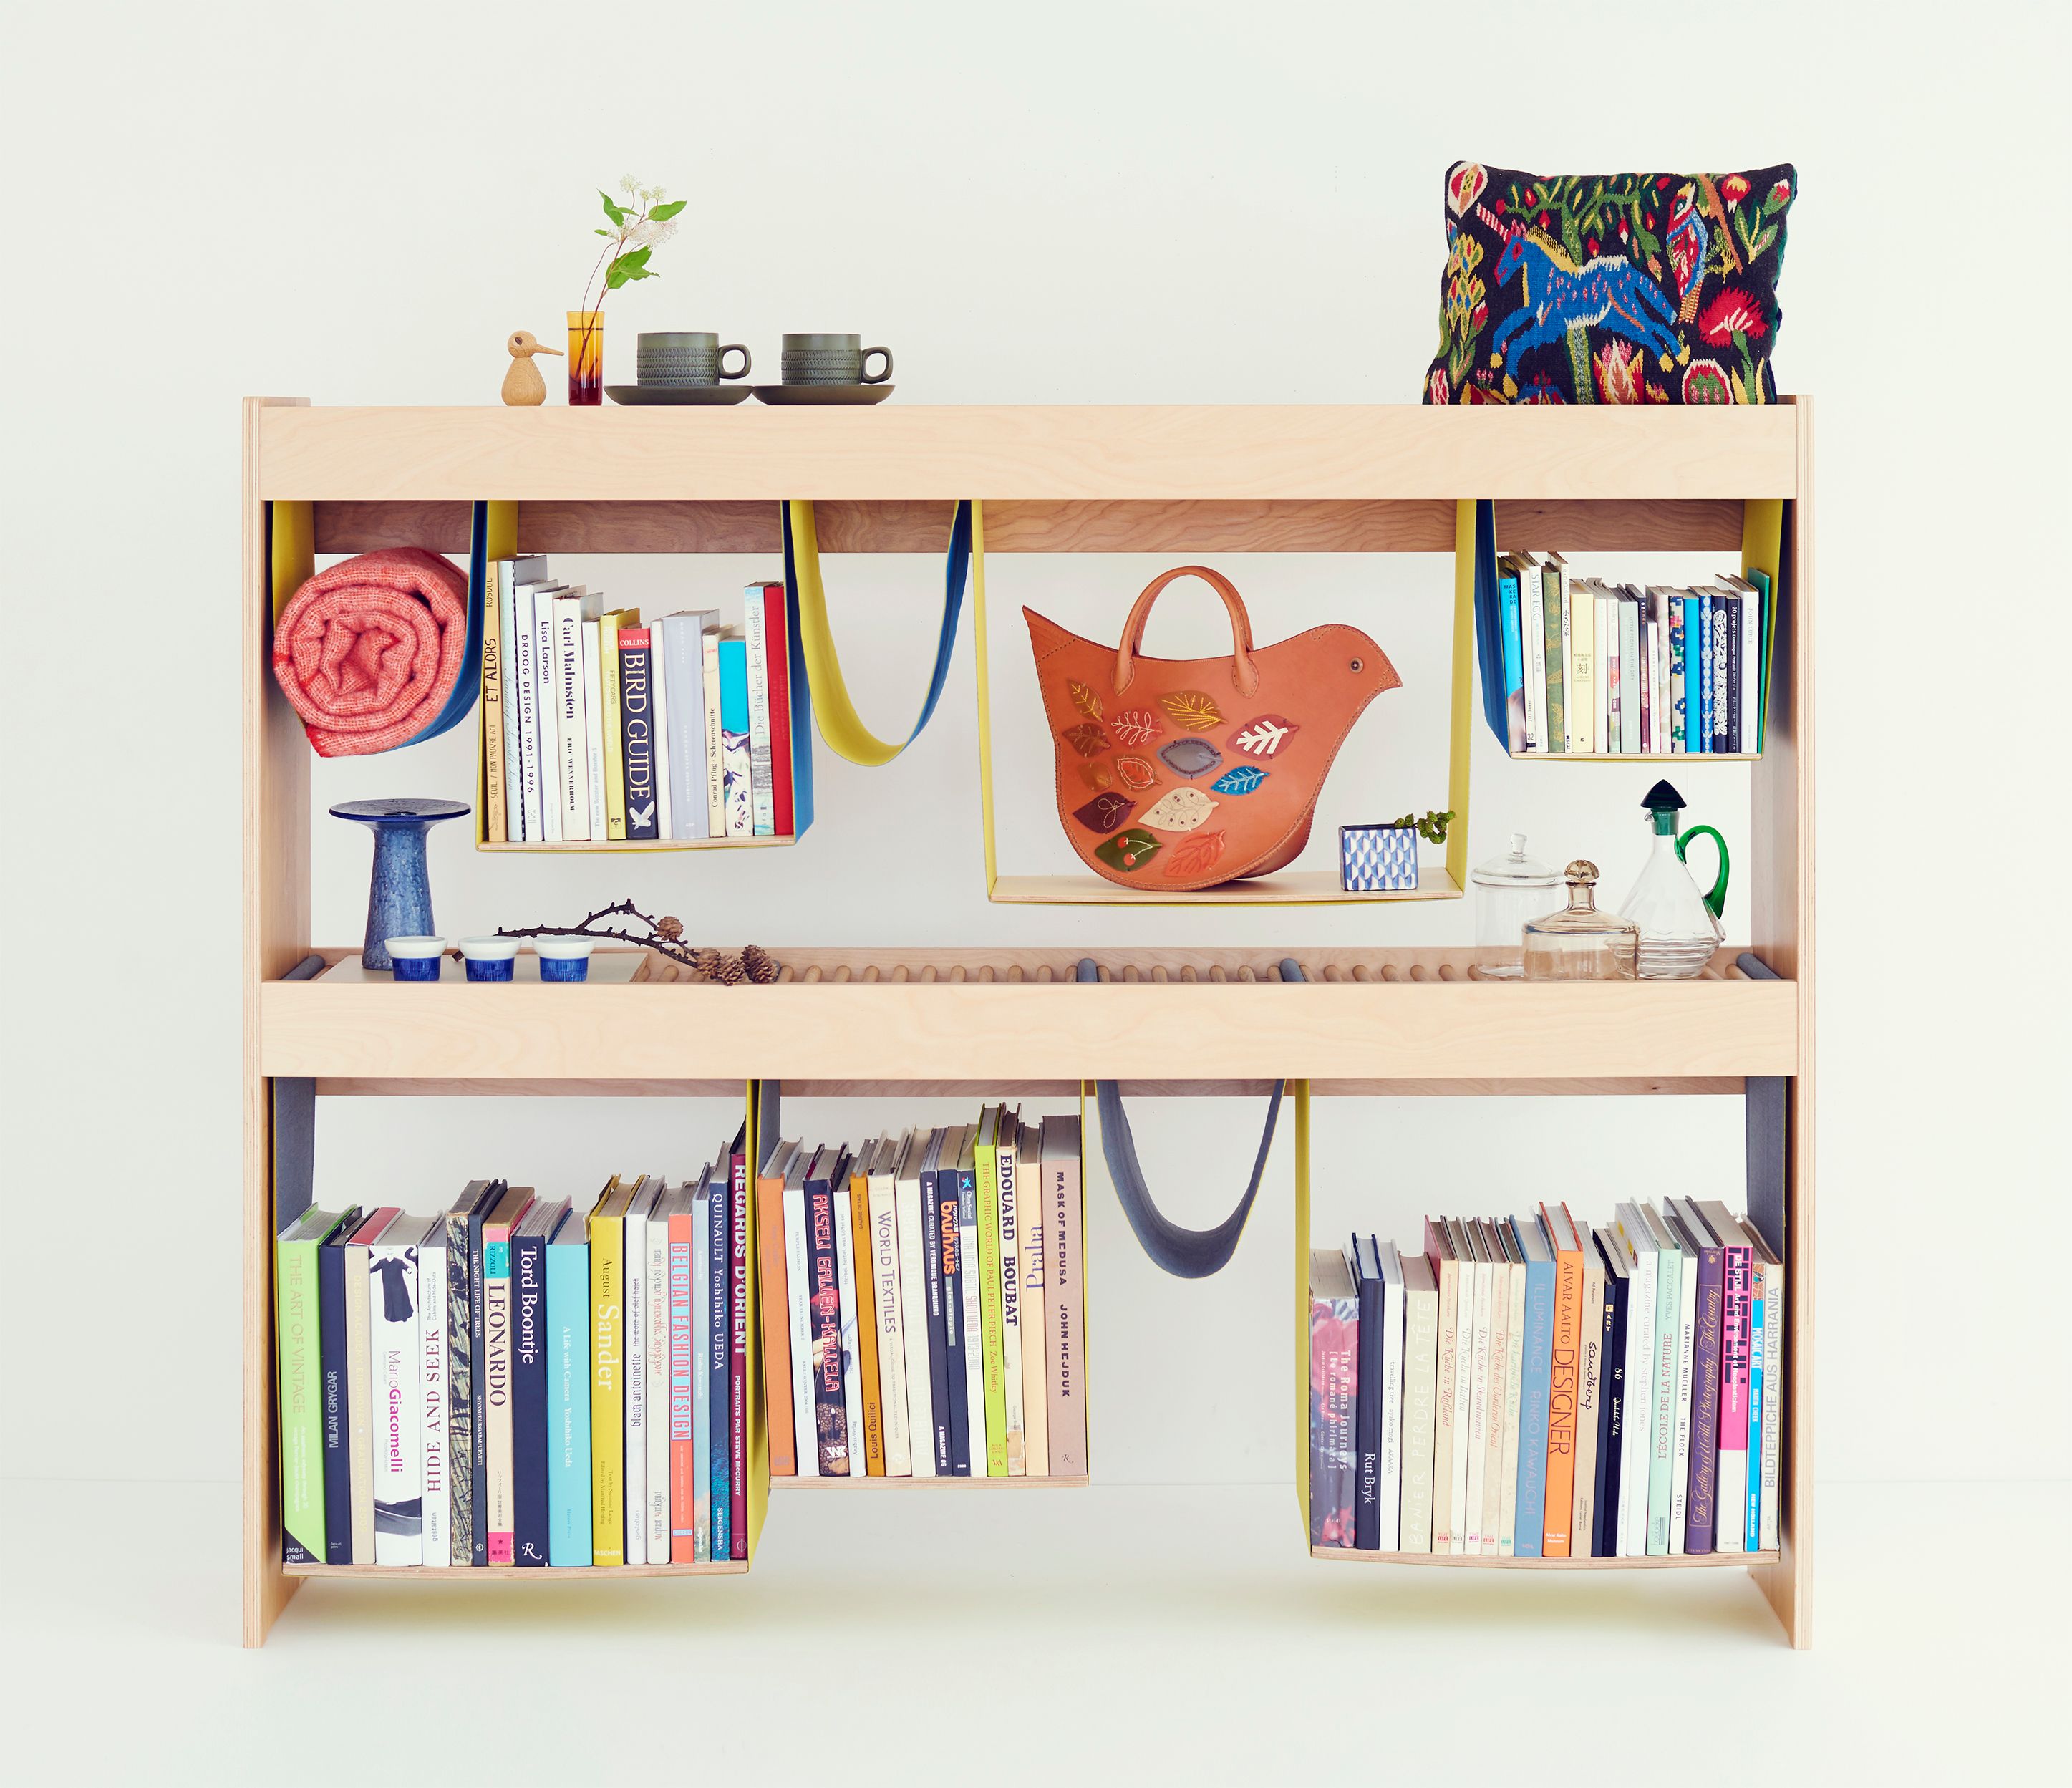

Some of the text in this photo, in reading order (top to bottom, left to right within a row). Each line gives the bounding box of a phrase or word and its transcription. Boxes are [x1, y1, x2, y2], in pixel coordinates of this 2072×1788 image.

[1532, 601, 1541, 620] EGG
[485, 639, 498, 702] ET ALORS
[563, 618, 576, 719] Carl Malmsten
[752, 607, 765, 735] Die Bücher der Künstler
[521, 635, 534, 793] DROOG DESIGN 1991-1996
[624, 653, 651, 800] BIRD GUIDE
[926, 1187, 935, 1214] MAGAZINE
[984, 1181, 992, 1221] GRAPHIC
[1058, 1212, 1065, 1227] OF
[735, 1165, 746, 1356] REGARDS D'ORIENT
[878, 1212, 891, 1266] WORLD
[941, 1201, 959, 1275] bauhaus
[987, 1255, 994, 1268] OF
[1000, 1154, 1017, 1326] EDOUARD BOUBAT
[1058, 1231, 1067, 1285] MEDUSA
[1735, 1255, 1742, 1266] DE
[475, 1305, 480, 1315] OF
[518, 1246, 538, 1364] Tord Boontje
[712, 1194, 724, 1369] QUINAULT Yoshihiko UEDA
[812, 1194, 840, 1392] AKSELI GALLEN-KALLELA
[881, 1270, 896, 1333] TEXTILES
[987, 1292, 997, 1320] PETER
[1666, 1260, 1675, 1300] PACCALET
[289, 1255, 305, 1413] THE ART OF VINTAGE
[488, 1285, 506, 1406] LEONARDO
[598, 1258, 619, 1391] August Sander
[672, 1246, 689, 1438] BELGIAN FASHION DESIGN
[989, 1321, 997, 1347] PIECH
[1060, 1305, 1068, 1339] JOHN
[1751, 1327, 1762, 1355] MOSAIC
[989, 1366, 998, 1393] Whitley
[1061, 1343, 1070, 1397] HEJDUK
[1549, 1262, 1574, 1454] ALVAR AALTO DESIGNER
[1751, 1356, 1762, 1369] ART
[1764, 1287, 1778, 1487] BILDTEPPICHE AUS HARRANIA
[327, 1371, 339, 1448] MILAN GRYGAR
[425, 1330, 441, 1492] HIDE AND SEEK
[1337, 1350, 1350, 1469] The Roma Journeys
[1524, 1283, 1546, 1514] ILLUMINANCE RINKO KAWAUCHI
[1657, 1333, 1672, 1459] L'ÉCOLE DE LA NATURE
[868, 1402, 878, 1459] Louis Quilici
[1361, 1453, 1375, 1504] Rut Bryk
[286, 1555, 304, 1563] small
